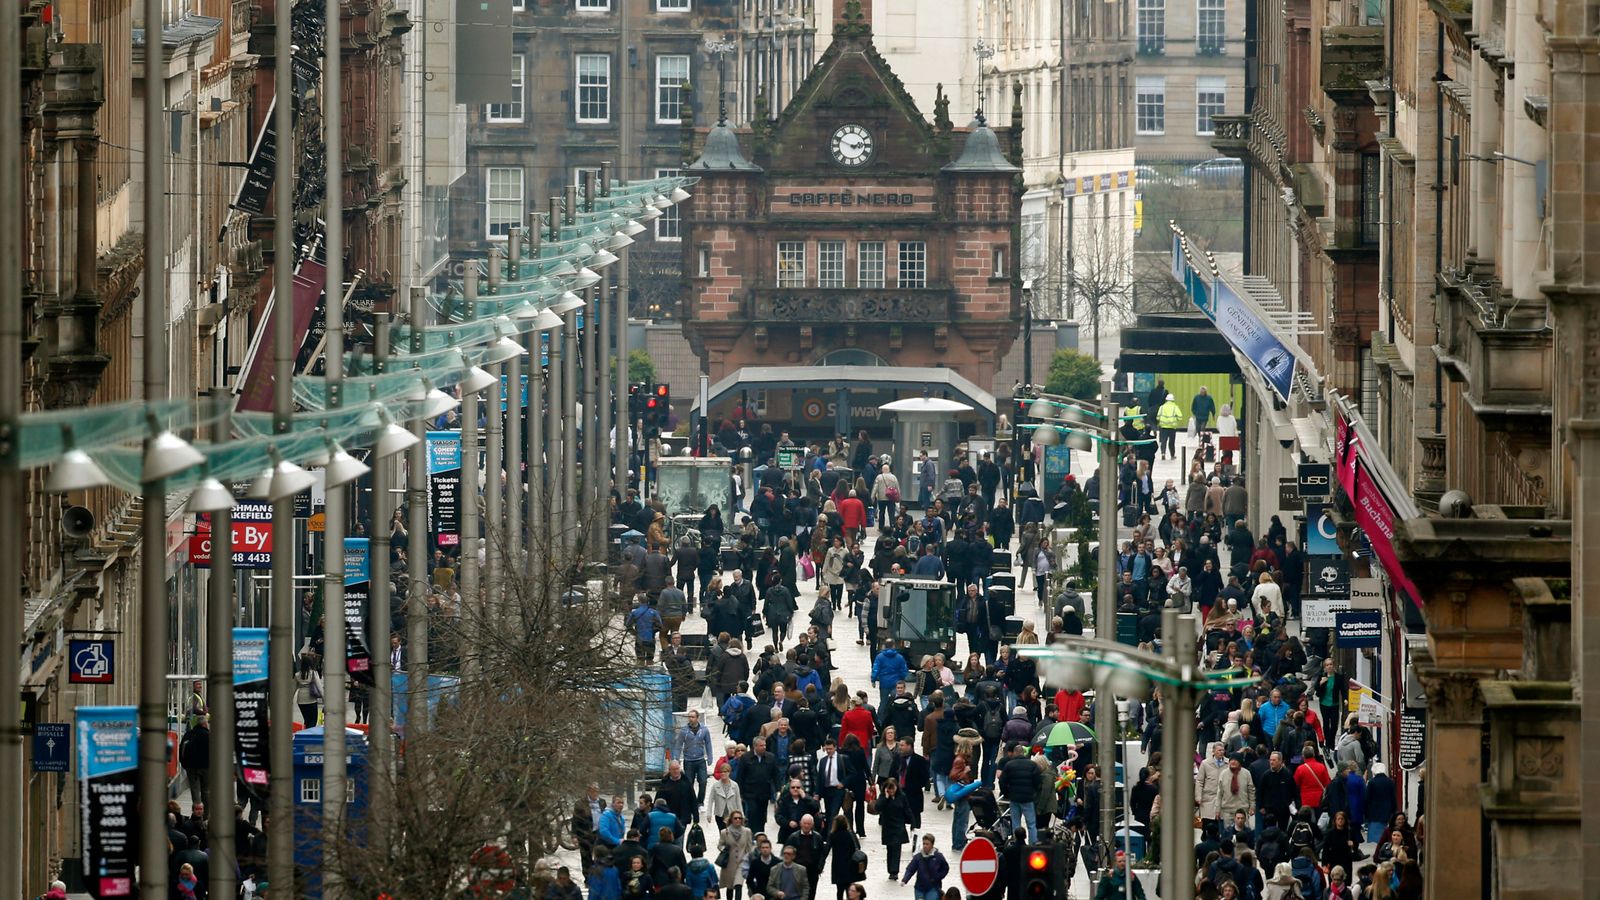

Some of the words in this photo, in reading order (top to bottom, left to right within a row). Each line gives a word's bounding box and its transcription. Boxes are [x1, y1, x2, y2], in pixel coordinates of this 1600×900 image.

[856, 193, 913, 206] NERO
[827, 403, 882, 420] Sway
[1300, 476, 1328, 485] USC
[245, 526, 268, 550] By
[247, 553, 271, 563] 4433
[1341, 622, 1377, 630] Carphone
[236, 701, 258, 709] 0844
[239, 710, 256, 718] 395
[92, 732, 132, 742] COMEDY
[91, 783, 134, 794] Tickets:
[99, 794, 127, 805] 0844
[103, 805, 124, 816] 395
[99, 816, 127, 827] 4005
